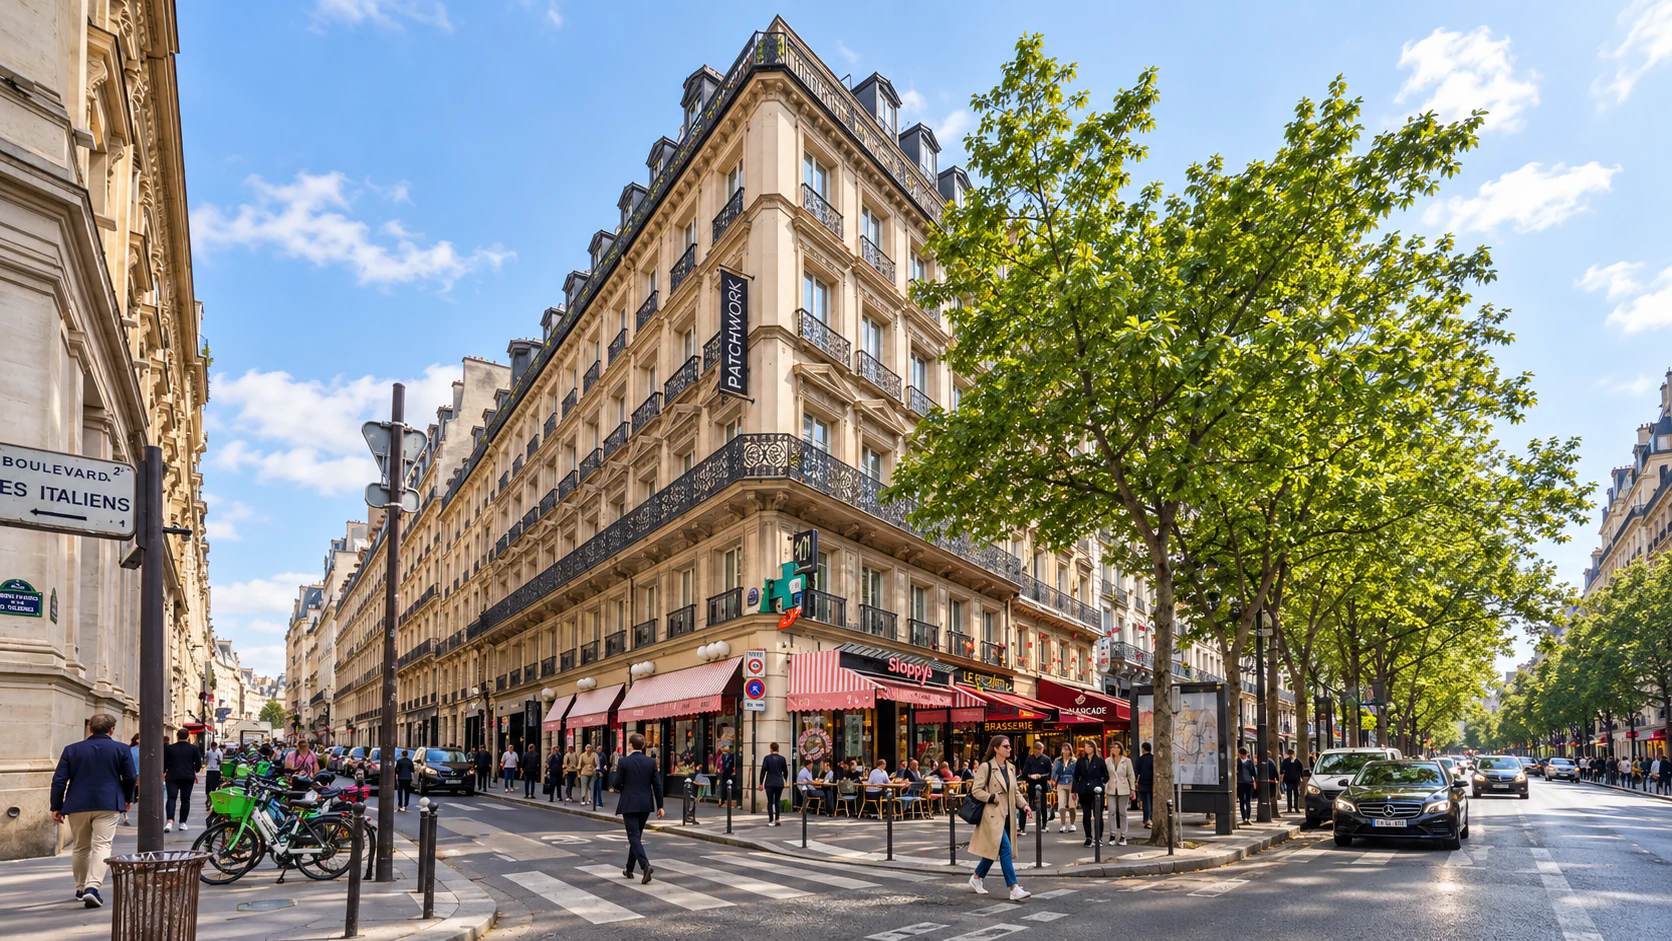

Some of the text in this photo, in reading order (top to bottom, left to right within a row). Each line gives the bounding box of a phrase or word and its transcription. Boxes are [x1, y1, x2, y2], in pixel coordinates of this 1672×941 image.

[727, 279, 742, 389] PATCHWORK
[40, 485, 131, 512] ITALIENS
[984, 721, 1033, 731] BRASSERIE
